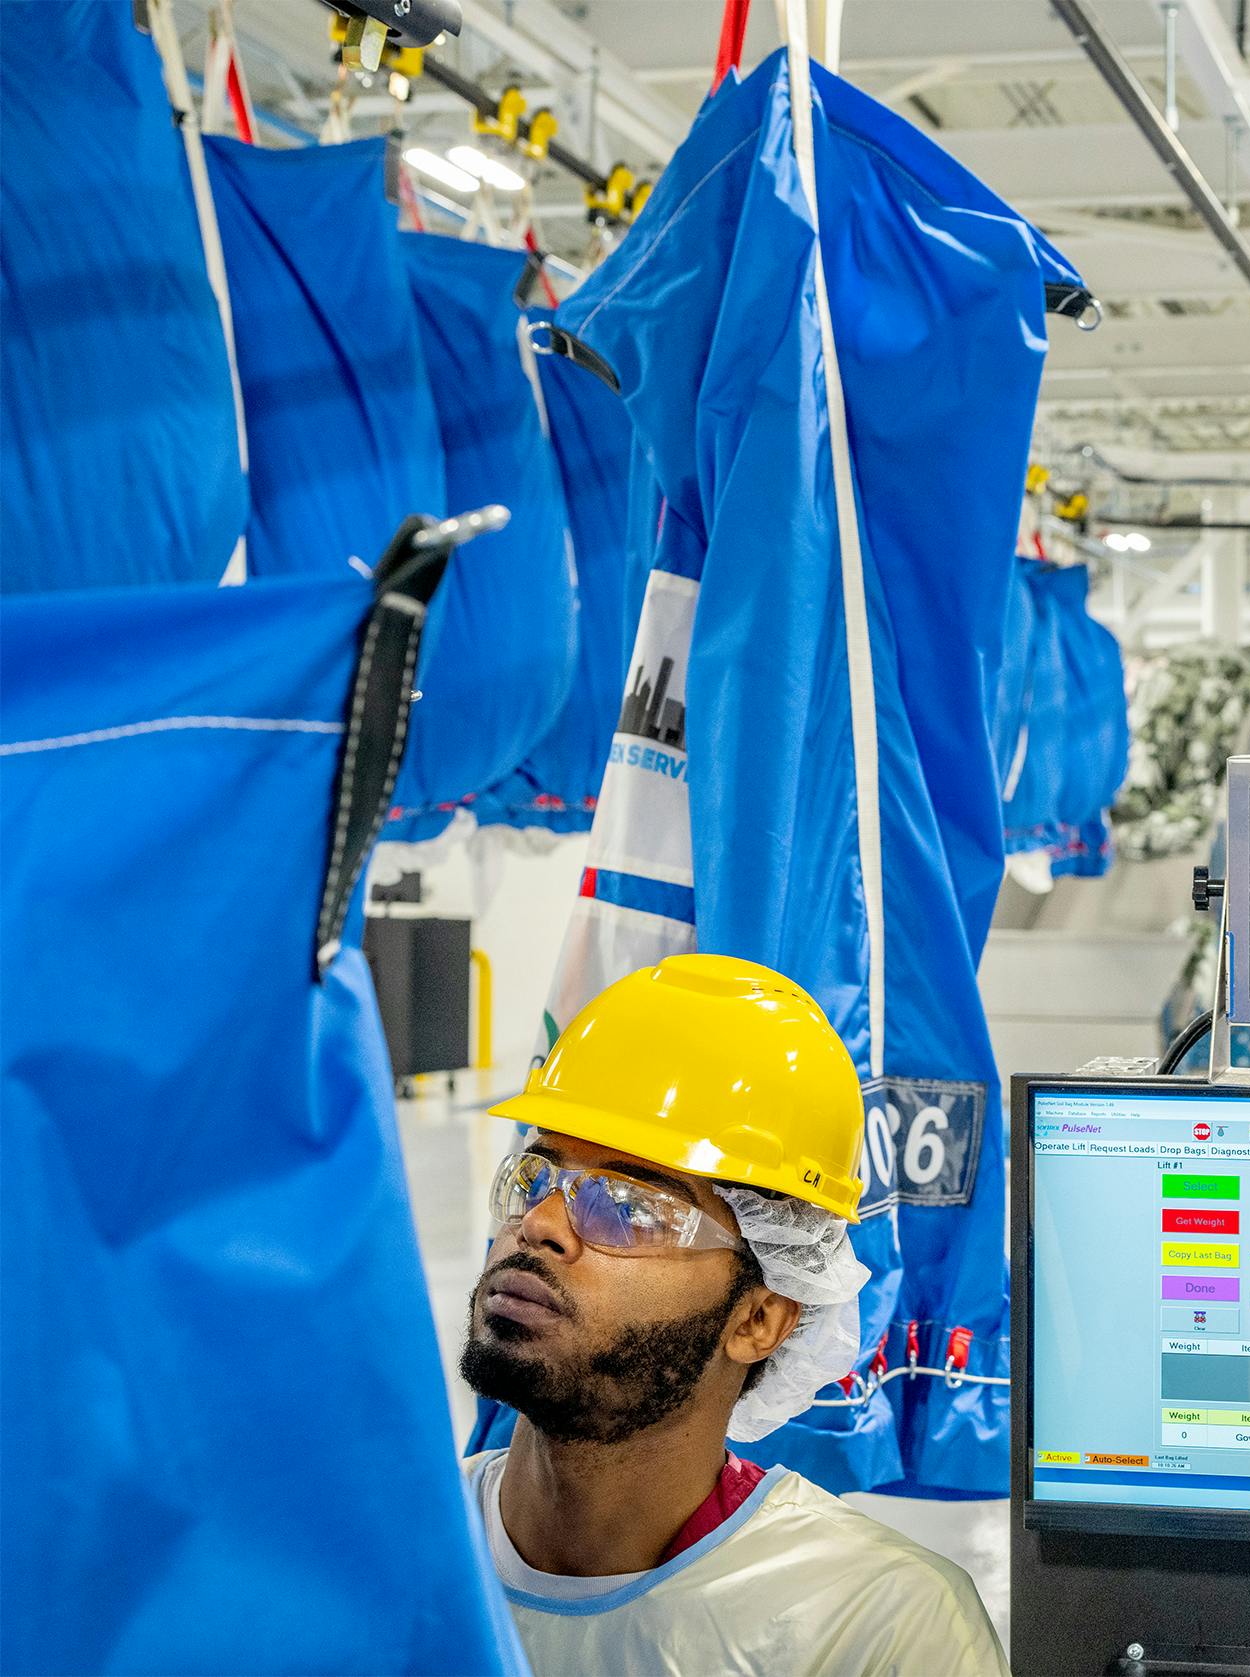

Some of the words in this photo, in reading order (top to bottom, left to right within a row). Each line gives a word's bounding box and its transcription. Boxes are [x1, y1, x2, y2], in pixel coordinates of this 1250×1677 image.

[1062, 1124, 1102, 1133] PulseNet
[1035, 1142, 1070, 1151] Operate
[1072, 1142, 1085, 1150] Lift
[1090, 1144, 1127, 1153] Request
[1129, 1145, 1155, 1153] Loads
[1160, 1146, 1181, 1155] Drop
[1184, 1147, 1206, 1156] Bags
[1184, 1181, 1218, 1191] Select
[1176, 1217, 1191, 1225] Get
[1193, 1218, 1225, 1227] Weight
[1169, 1250, 1192, 1260] Copy
[1194, 1251, 1212, 1259] Last
[1215, 1252, 1232, 1261] Bag
[1186, 1283, 1215, 1293] Done
[1169, 1342, 1200, 1351] Weight
[1169, 1412, 1200, 1421] Weight
[1092, 1456, 1143, 1465] Auto-Select
